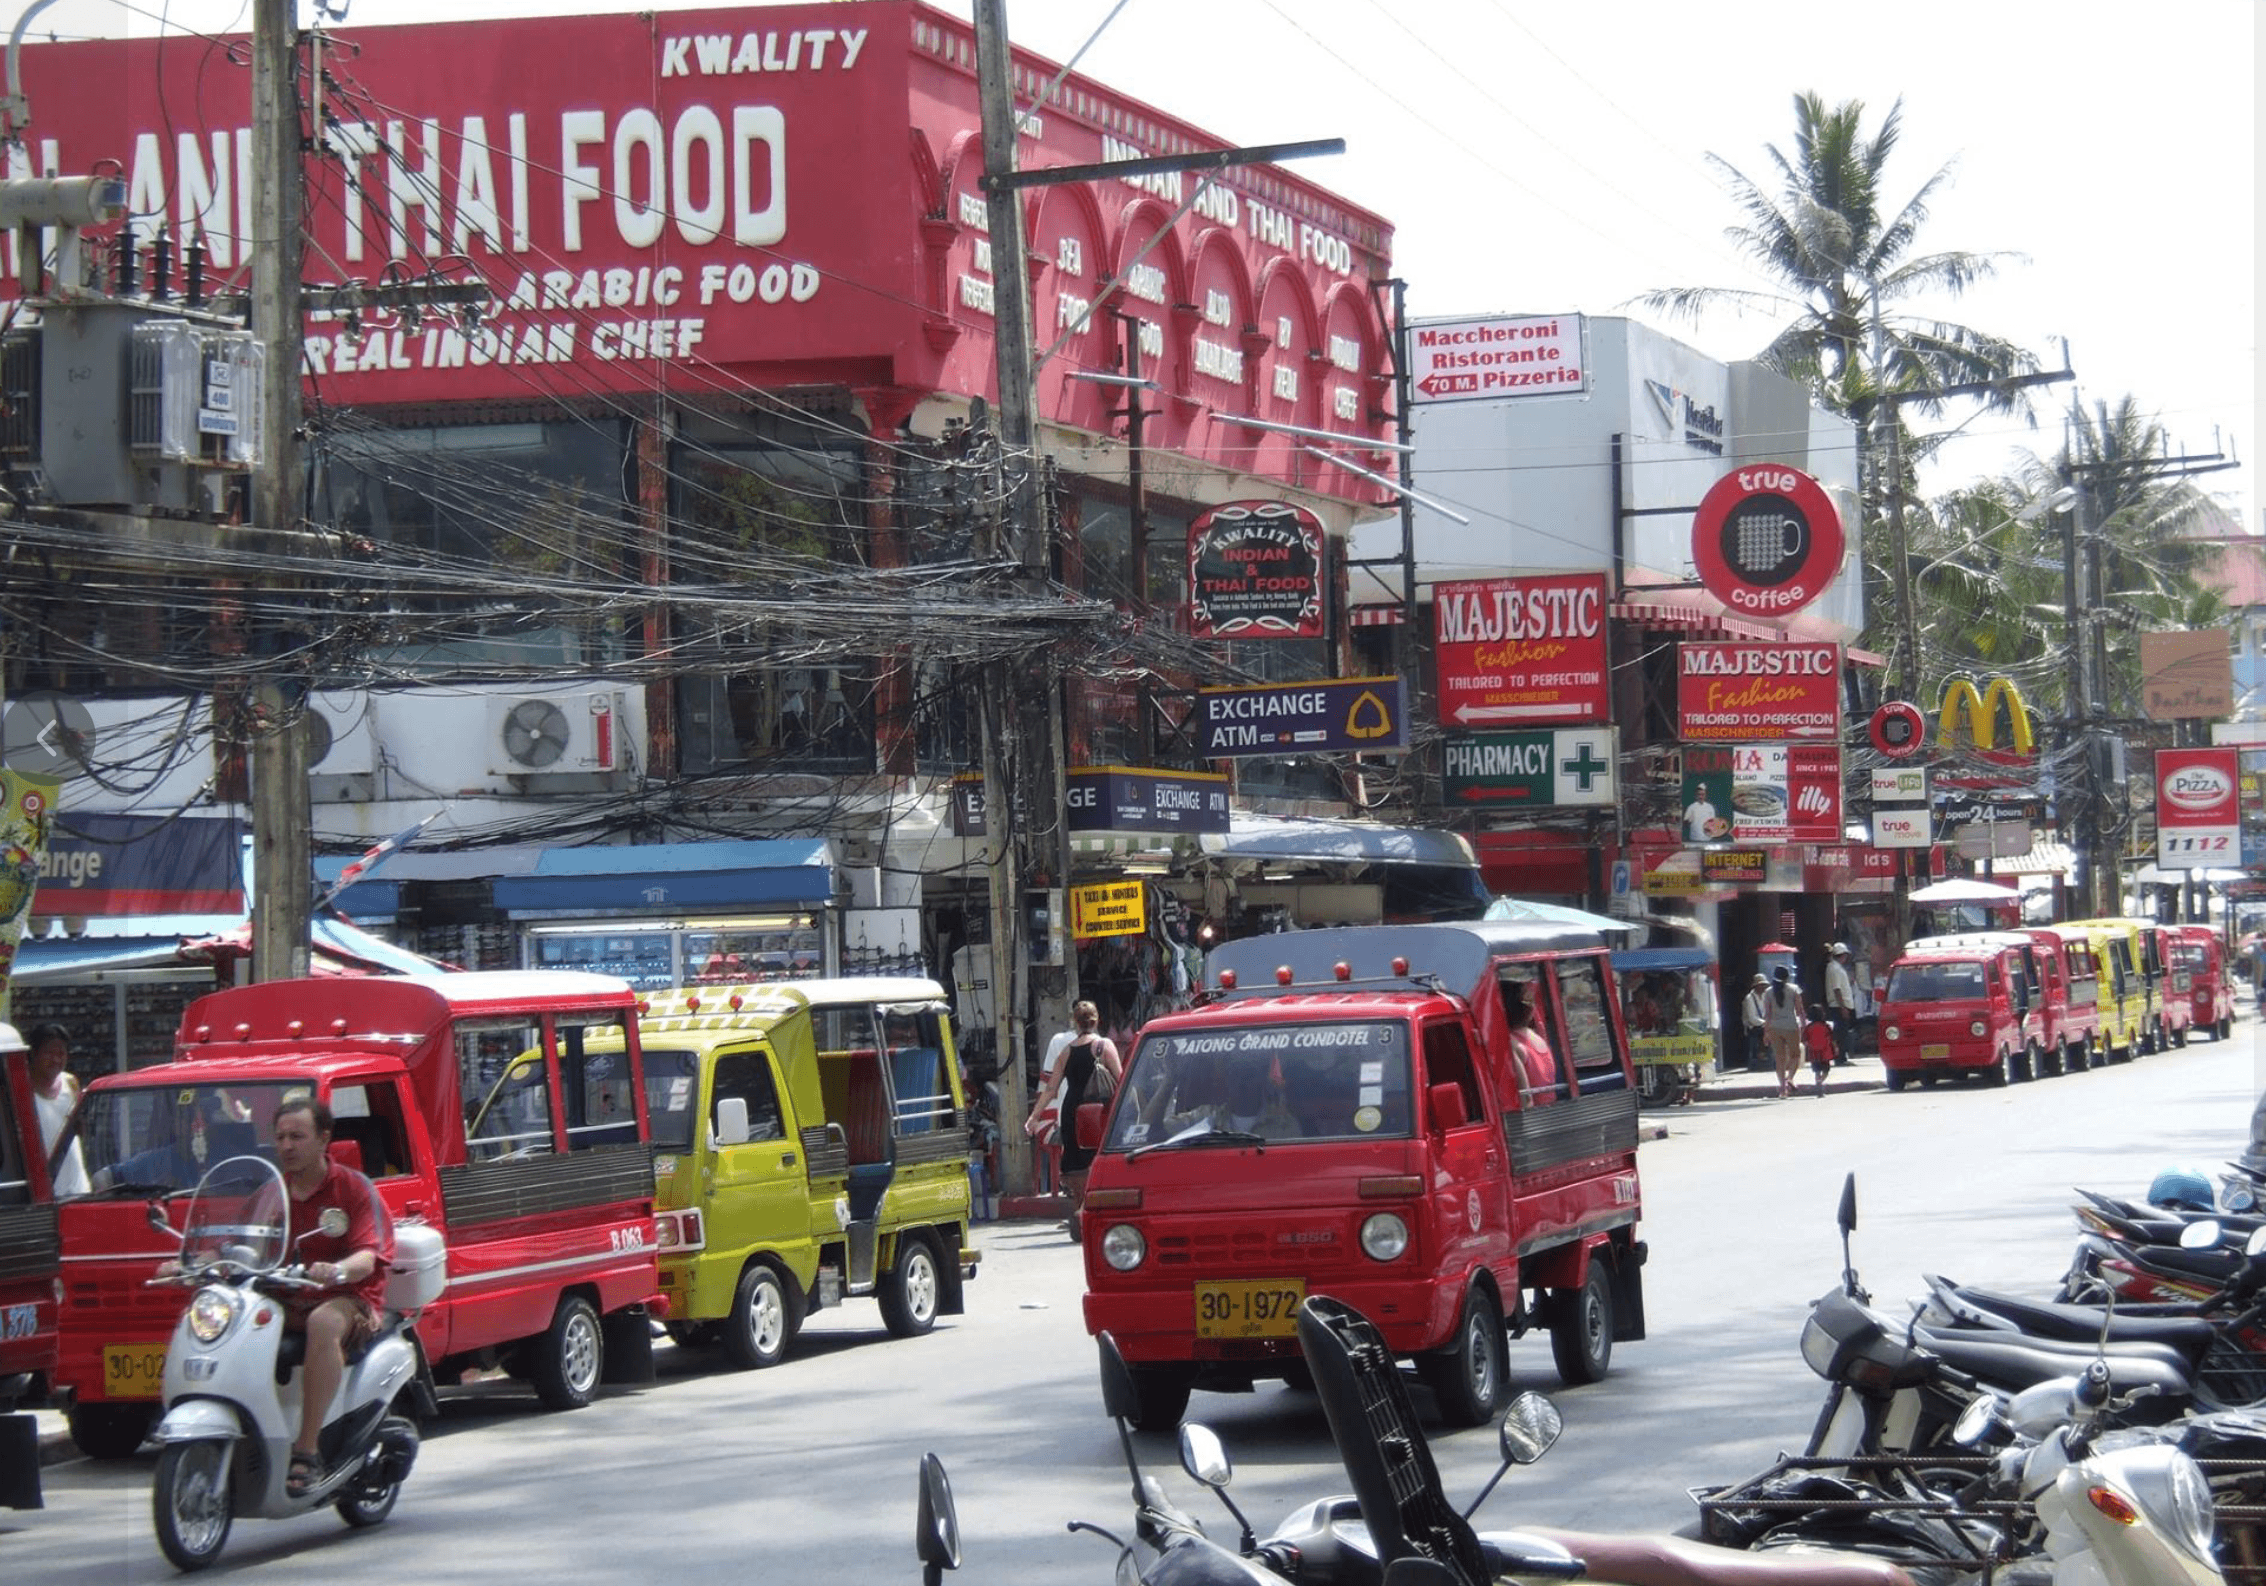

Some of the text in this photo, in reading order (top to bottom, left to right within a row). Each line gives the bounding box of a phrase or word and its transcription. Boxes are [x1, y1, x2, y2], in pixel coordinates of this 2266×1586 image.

[661, 29, 868, 77] KWALITY
[128, 127, 253, 269] AN
[325, 113, 529, 262] THAI
[562, 105, 787, 251] FOOD
[1193, 176, 1238, 228] AND
[1247, 198, 1293, 252] THAI
[1301, 223, 1350, 277] FOOD
[508, 266, 682, 311] ARABIC
[701, 262, 820, 306] FOOD
[1418, 320, 1558, 347] Maccheroni
[302, 318, 705, 375] REAL INDIAN CHEF
[1433, 346, 1560, 369] Ristorante
[1429, 378, 1450, 392] 70
[1483, 366, 1579, 389] Pizzeria
[1738, 471, 1797, 492] true
[1212, 527, 1300, 551] KWALITY
[1223, 549, 1290, 561] INDIAN
[1246, 563, 1258, 577] &
[1202, 576, 1310, 592] THAI FOOD
[1438, 587, 1599, 643] MAJESTIC
[1683, 649, 1833, 675] MAJESTIC
[1448, 672, 1599, 690] TAILORED TO PERFECTION
[1209, 693, 1327, 720] EXCHANGE
[1707, 677, 1806, 711] Fashion
[1684, 713, 1834, 725] TAILORED TO PERFECTION
[1211, 725, 1258, 748] ATM
[1446, 744, 1550, 776] PHARMACY
[1872, 779, 1897, 789] true
[1156, 789, 1225, 811] EXCHANGE ATM
[1797, 785, 1831, 818] illy
[1882, 821, 1911, 831] true
[1945, 811, 1971, 820] open
[1970, 805, 1996, 823] 24
[2167, 836, 2229, 851] 1112
[1704, 853, 1764, 867] INTERNET
[1173, 1037, 1236, 1055] PATONG
[1239, 1033, 1291, 1051] GRAND
[1293, 1030, 1369, 1048] CONDOTEL
[1379, 1027, 1394, 1045] 3
[1201, 1290, 1298, 1320] 30-1972
